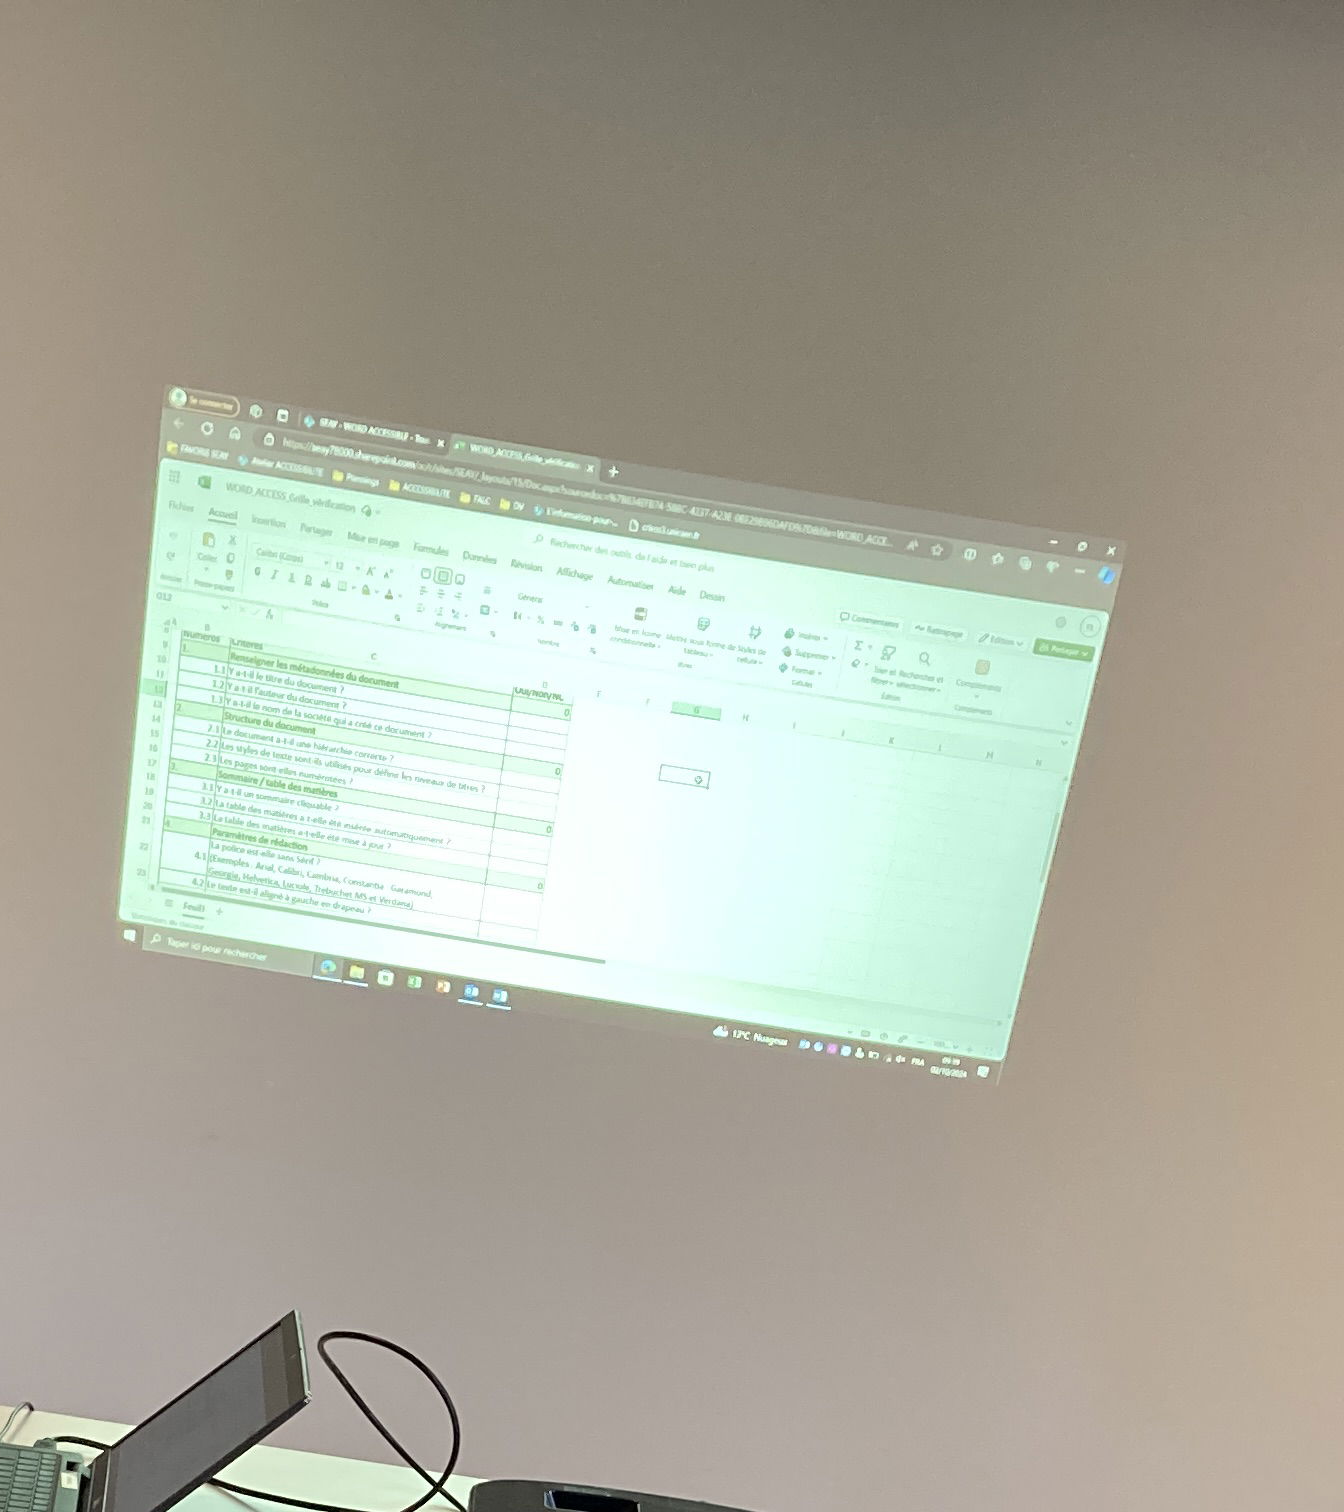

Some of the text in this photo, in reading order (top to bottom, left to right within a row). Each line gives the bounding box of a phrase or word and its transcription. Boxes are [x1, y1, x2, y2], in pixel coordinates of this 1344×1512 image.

[208, 507, 238, 521] Accueil
[251, 514, 286, 529] Insertion
[412, 541, 449, 557] Formules
[549, 537, 592, 553] Rechercher
[462, 549, 497, 565] Données
[510, 557, 543, 572] Révision
[555, 565, 593, 582] Affichage
[667, 584, 687, 597] Aide
[229, 651, 274, 668] Renseigner
[288, 661, 345, 679] métadonnées
[358, 673, 399, 689] document
[296, 678, 337, 693] document
[298, 694, 339, 709] document
[223, 711, 261, 726] Structure
[274, 720, 316, 735] document
[261, 704, 280, 714] nom
[384, 724, 425, 739] document
[233, 728, 274, 742] document
[233, 759, 257, 772] pages
[353, 766, 372, 776] pour
[217, 769, 258, 784] Sommaire
[265, 777, 286, 789] table
[302, 785, 338, 798] matières
[225, 800, 246, 811] table
[262, 807, 298, 821] matières
[211, 827, 257, 843] Paramètres
[270, 837, 308, 851] rédaction
